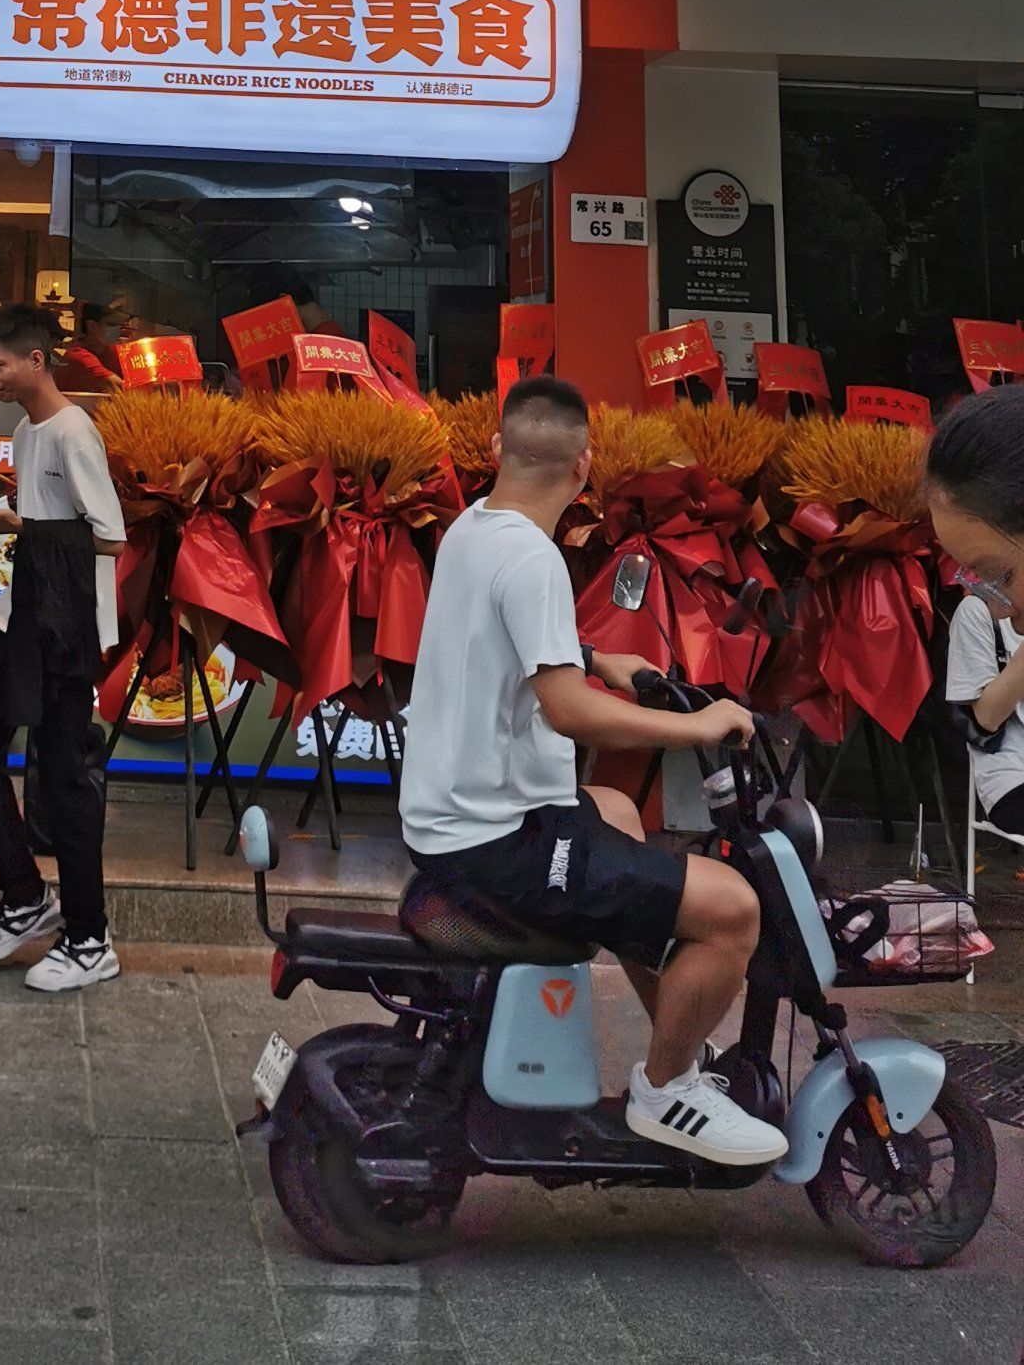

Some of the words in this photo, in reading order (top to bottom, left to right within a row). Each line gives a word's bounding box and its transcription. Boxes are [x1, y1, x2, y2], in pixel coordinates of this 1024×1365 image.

[63, 67, 133, 84] 地道常德粉
[163, 71, 248, 89] CHANGDE
[251, 73, 292, 91] RICE
[294, 74, 375, 94] NOODLES
[405, 80, 474, 97] 认准胡德记
[576, 200, 625, 215] 常兴路
[589, 220, 613, 237] 65
[691, 246, 743, 260] 营业时间
[304, 344, 362, 365] 開業大吉
